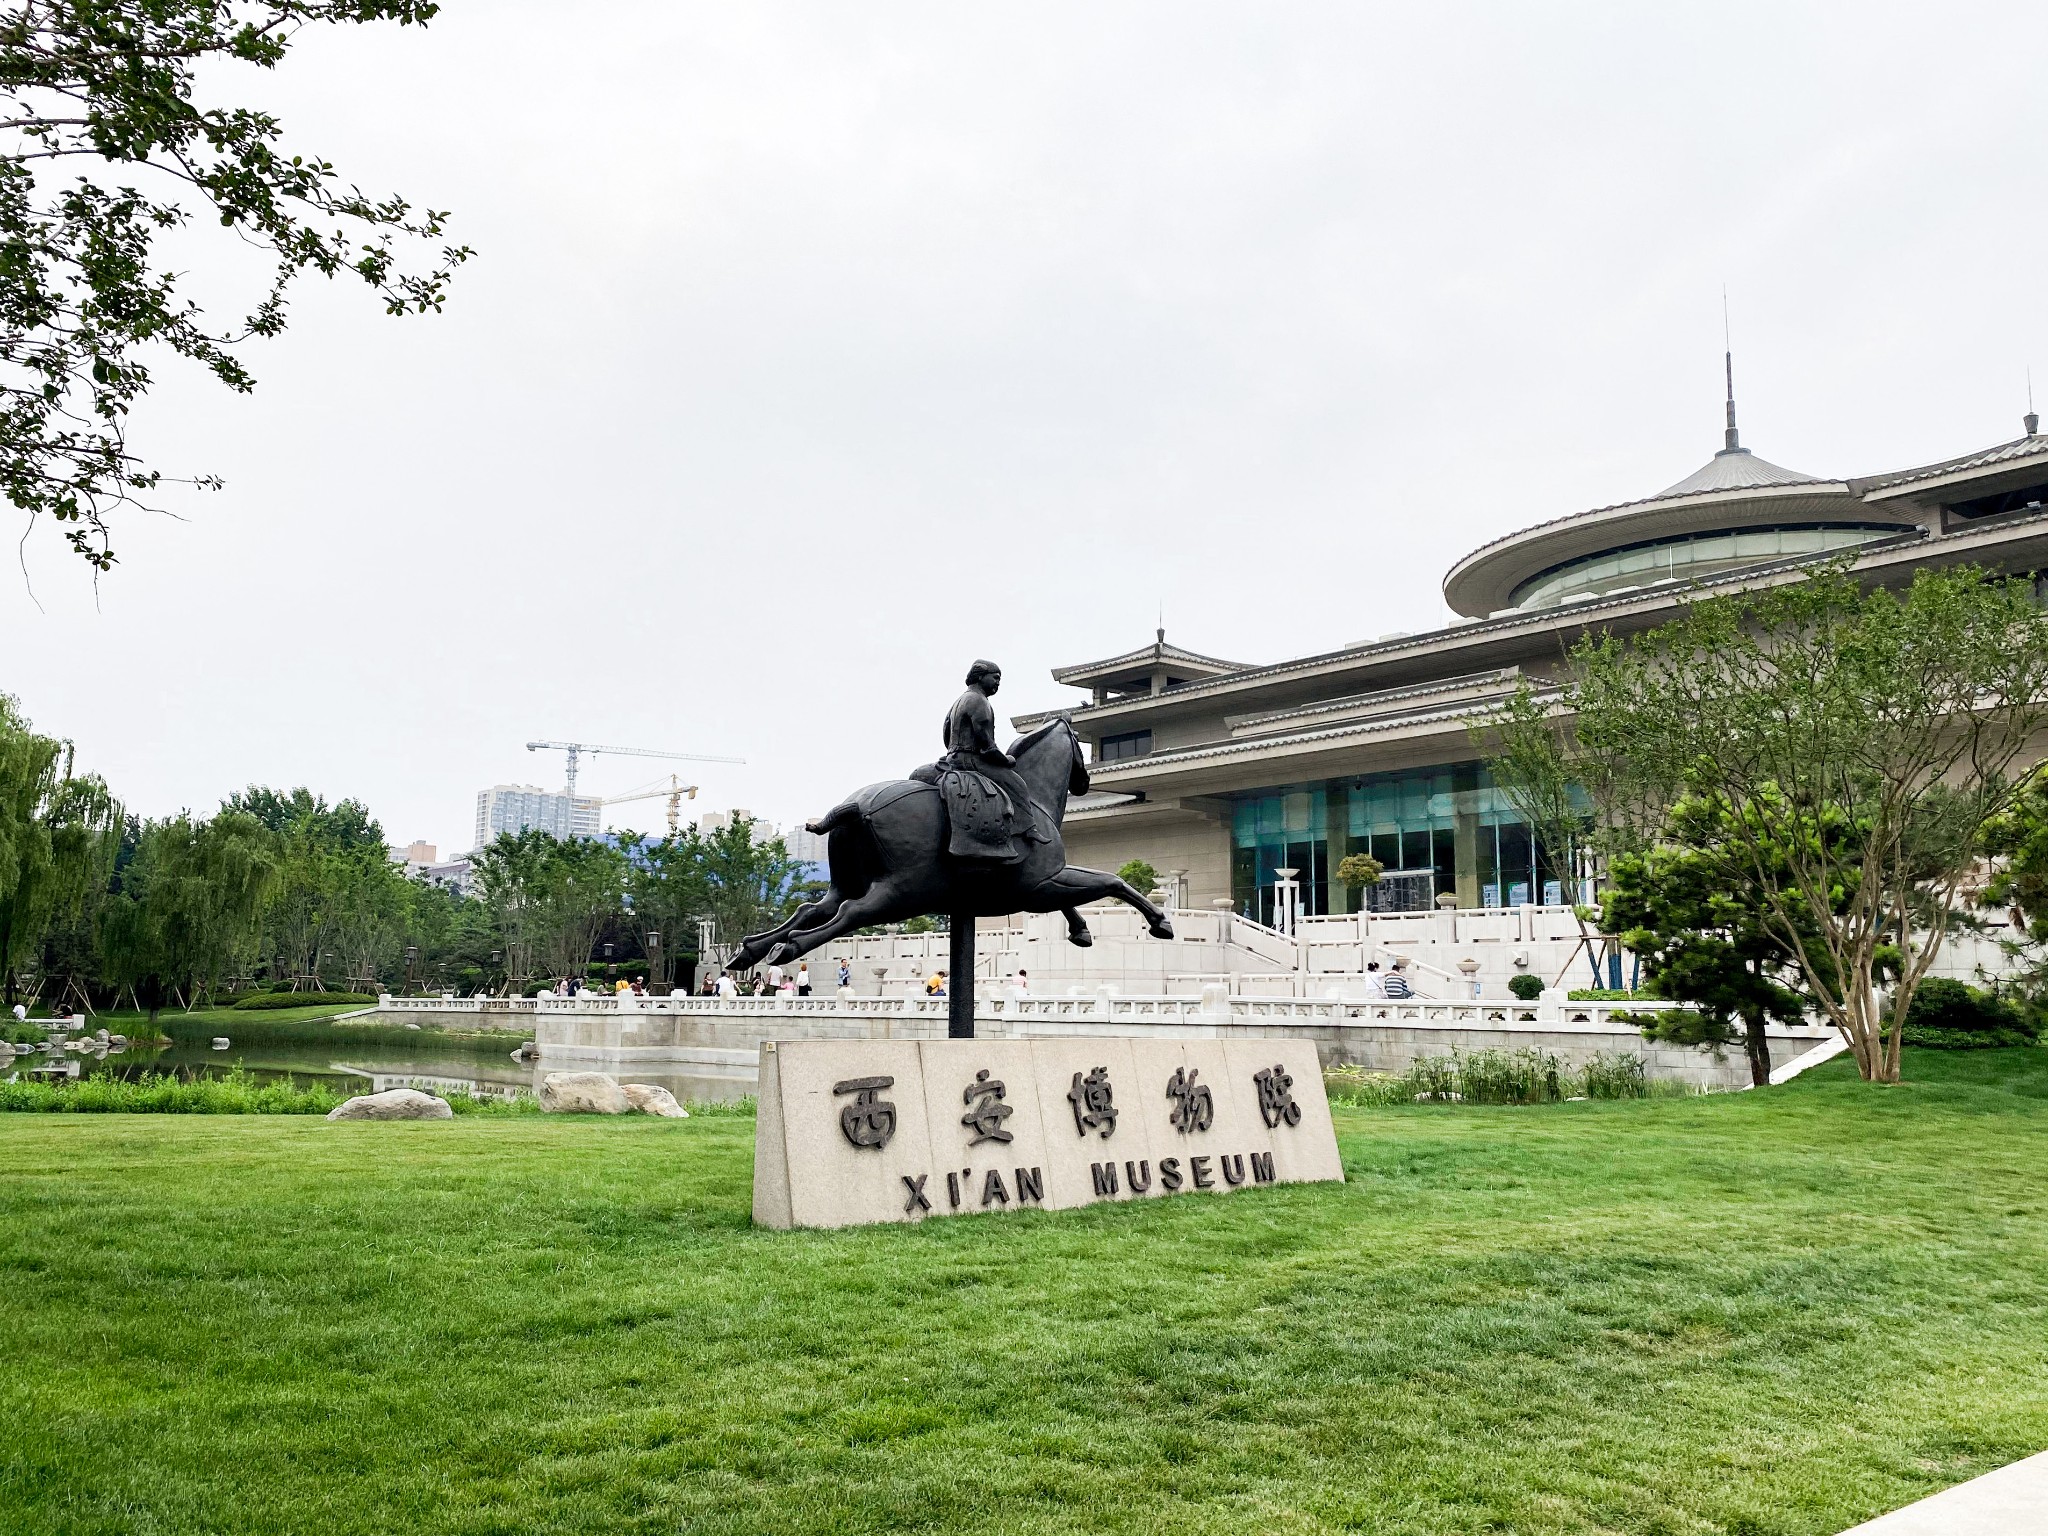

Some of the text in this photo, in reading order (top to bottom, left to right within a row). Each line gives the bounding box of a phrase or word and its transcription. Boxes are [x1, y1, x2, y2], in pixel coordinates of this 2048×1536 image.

[833, 1064, 1302, 1149] 西安博物院
[901, 1152, 1276, 1212] XI'AN MUSEUM
